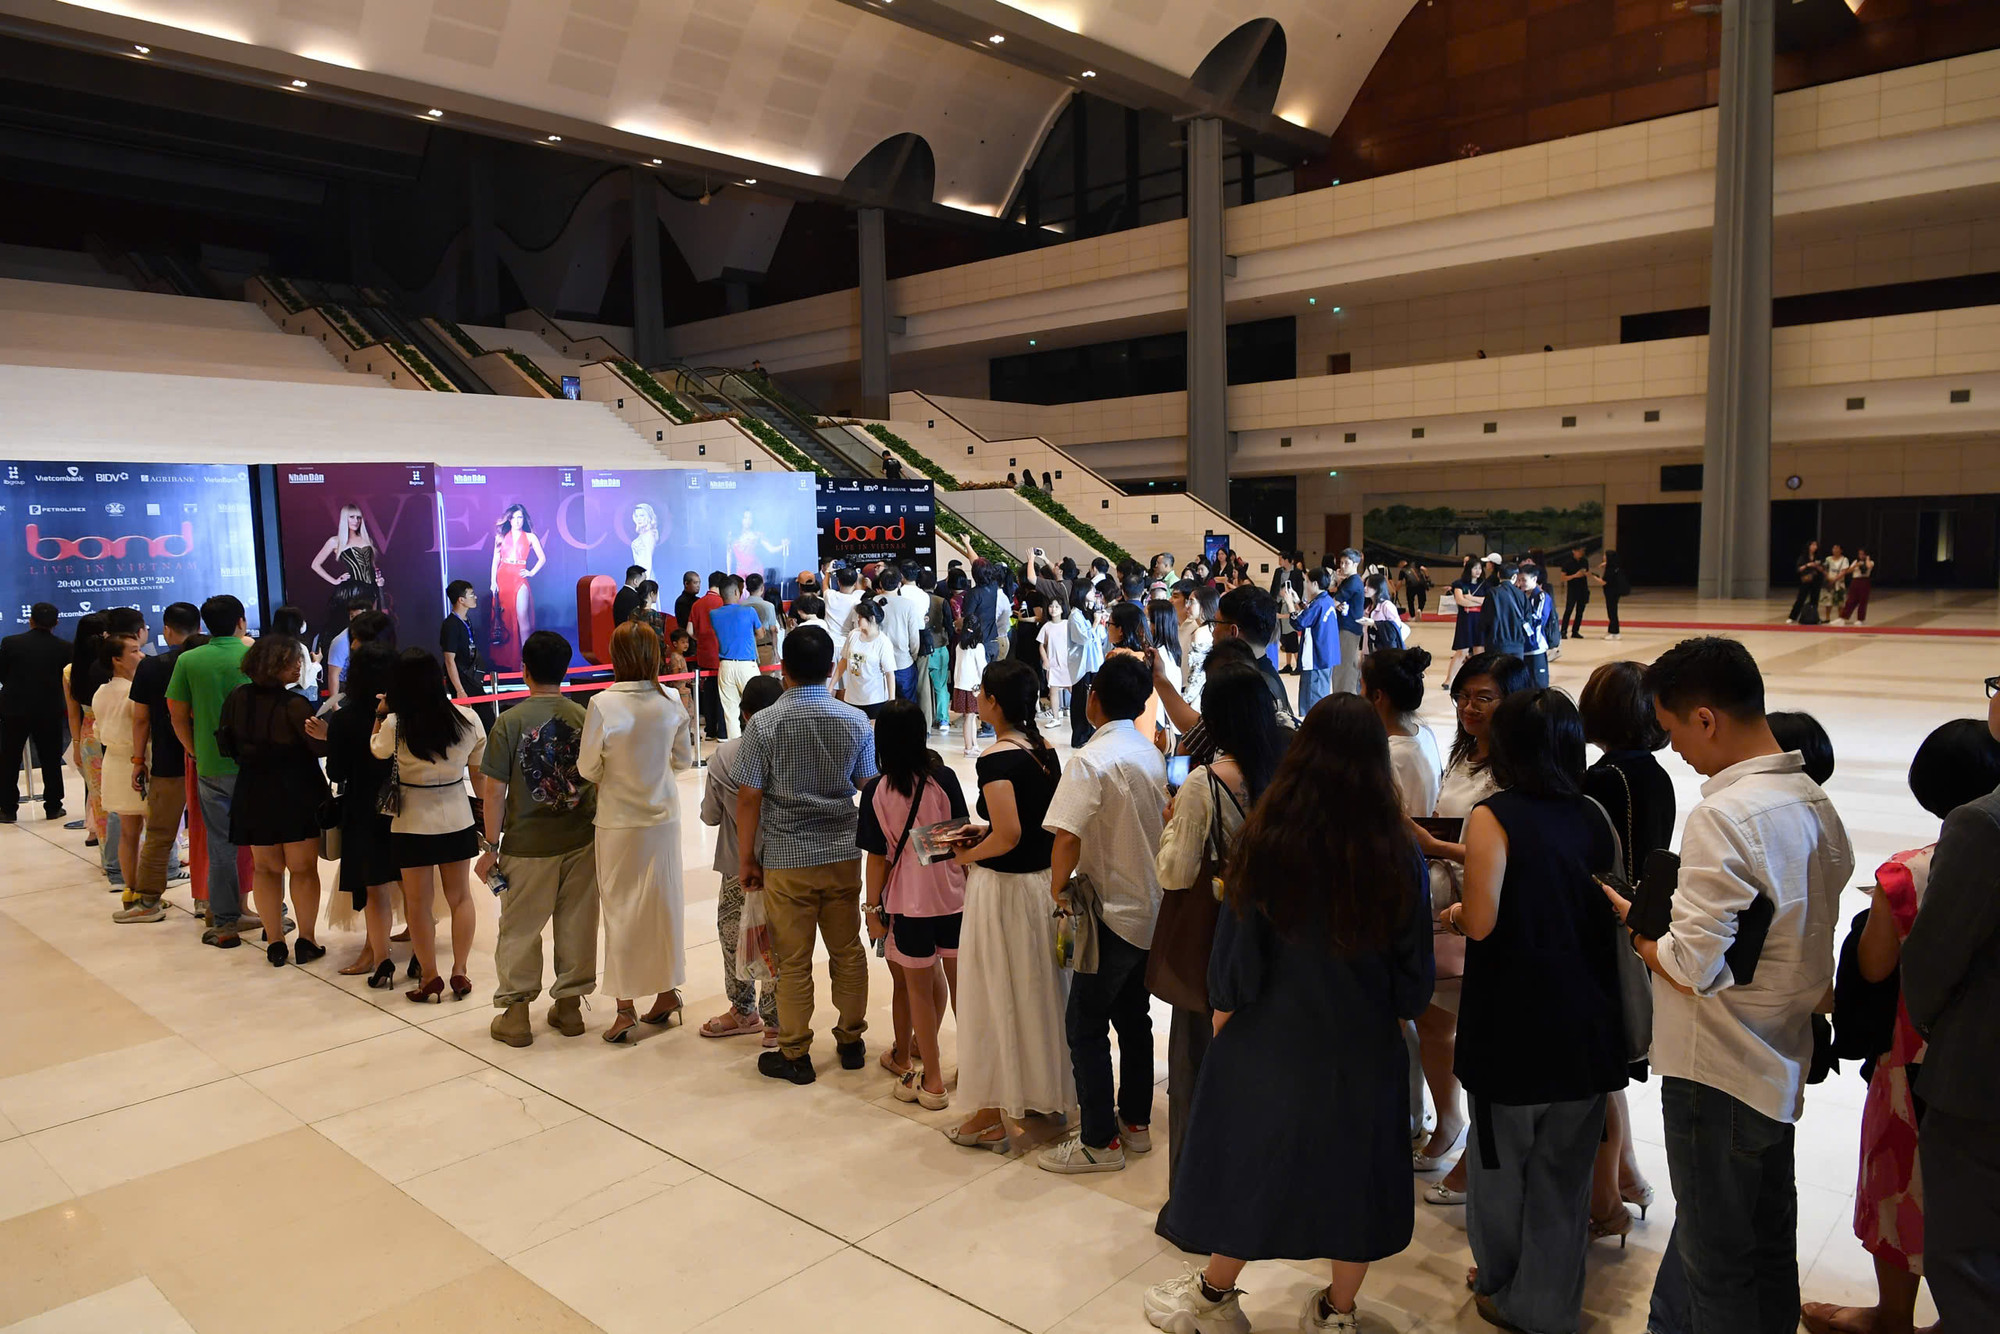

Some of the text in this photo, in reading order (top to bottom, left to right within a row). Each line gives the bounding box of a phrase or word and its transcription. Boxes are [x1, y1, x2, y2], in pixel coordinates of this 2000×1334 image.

[35, 475, 85, 483] Vietcombank
[95, 473, 120, 482] BIDV
[834, 516, 905, 542] bond
[25, 521, 194, 561] bond
[29, 561, 198, 576] LIVE IN VIETNAM
[57, 579, 81, 588] 20:00
[85, 577, 138, 587] OCTOBER
[155, 576, 175, 585] 2024
